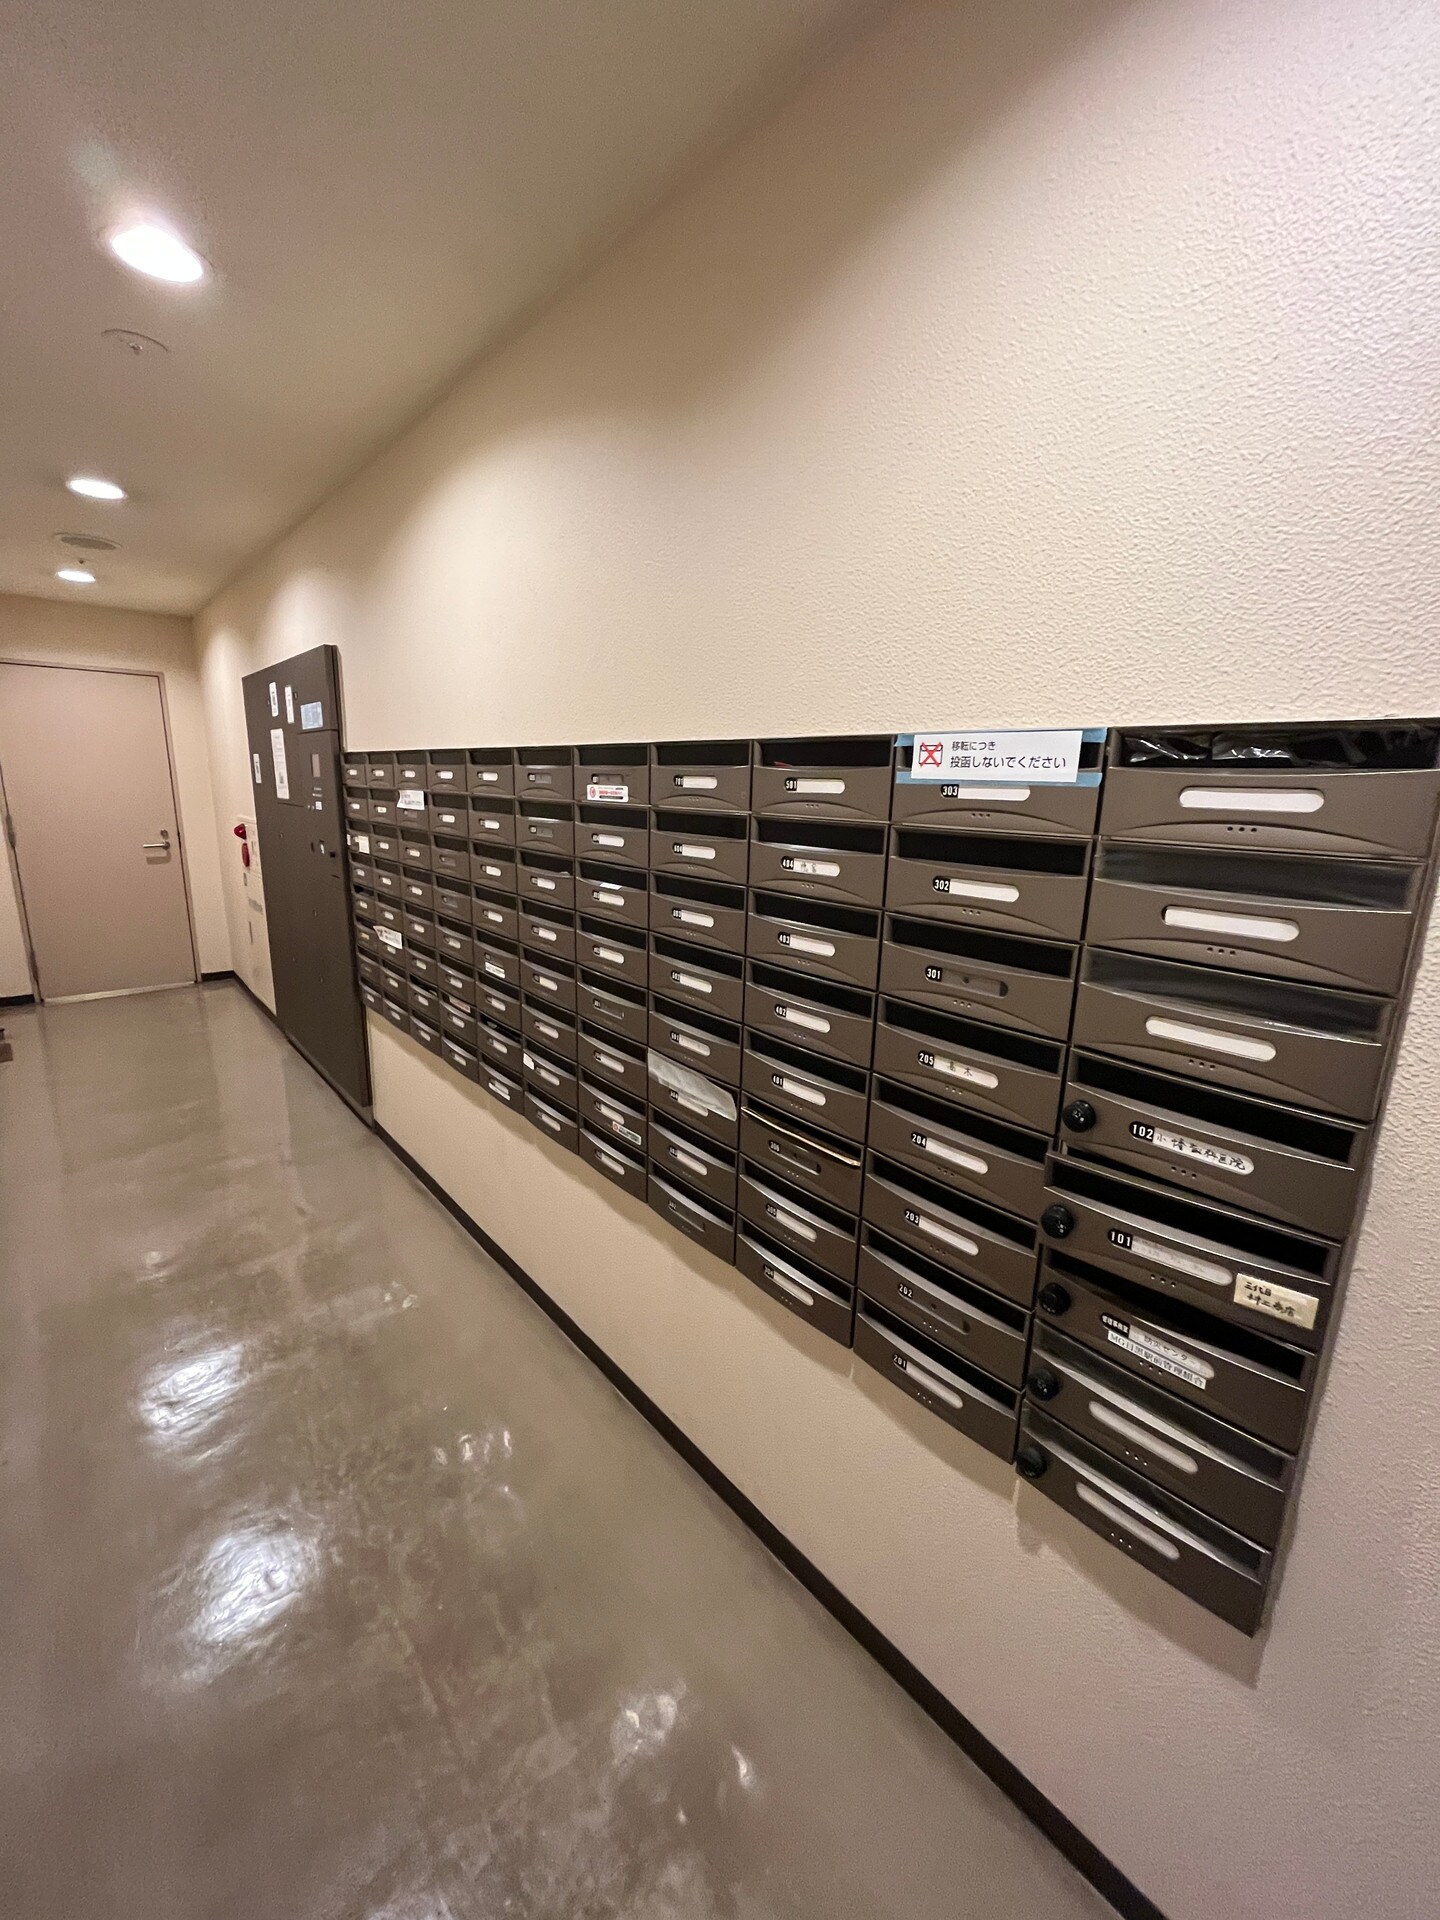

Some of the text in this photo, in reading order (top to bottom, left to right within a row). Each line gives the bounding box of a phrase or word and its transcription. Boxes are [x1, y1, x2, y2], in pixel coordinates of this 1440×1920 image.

[951, 740, 996, 751] 移転につき
[949, 755, 1066, 769] 投函しないでください
[942, 785, 958, 796] 303
[934, 879, 949, 891] 302
[926, 968, 941, 980] 301
[919, 1052, 934, 1066] 205
[1132, 1124, 1154, 1140] 102
[912, 1133, 926, 1147] 204
[905, 1210, 919, 1224] 203
[1111, 1231, 1132, 1247] 101
[898, 1284, 913, 1298] 202
[893, 1354, 907, 1367] 201
